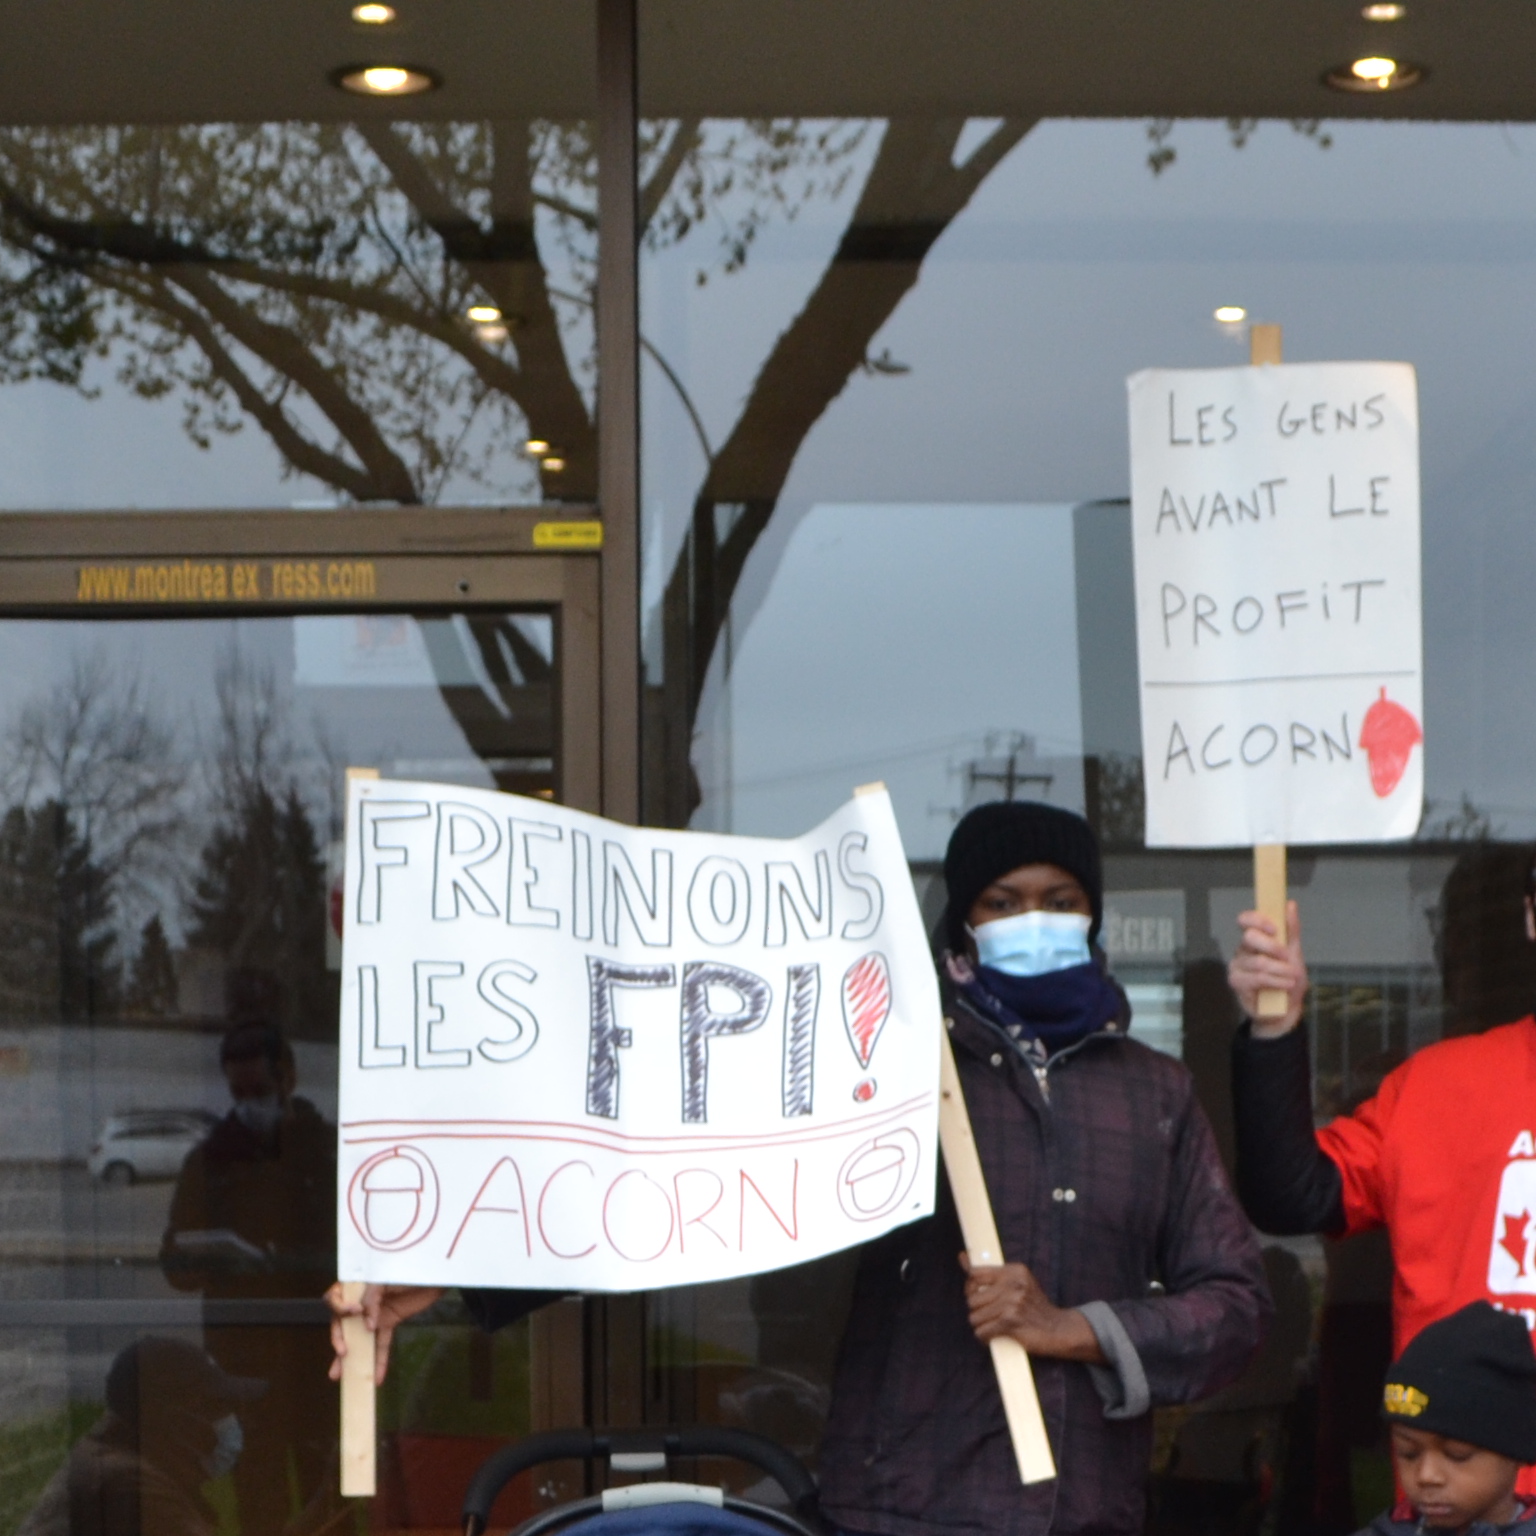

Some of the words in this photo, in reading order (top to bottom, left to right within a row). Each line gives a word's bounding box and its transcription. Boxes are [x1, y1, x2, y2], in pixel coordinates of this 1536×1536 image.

[1168, 391, 1237, 447] LES
[1277, 394, 1386, 437] GENS
[1155, 478, 1288, 534] AVANT
[1328, 474, 1390, 518] LE
[1163, 713, 1354, 781] ACORN
[357, 799, 884, 947] FREINONS
[358, 959, 539, 1069] LES
[585, 951, 893, 1123] FPI!
[446, 1156, 797, 1262] ACORN
